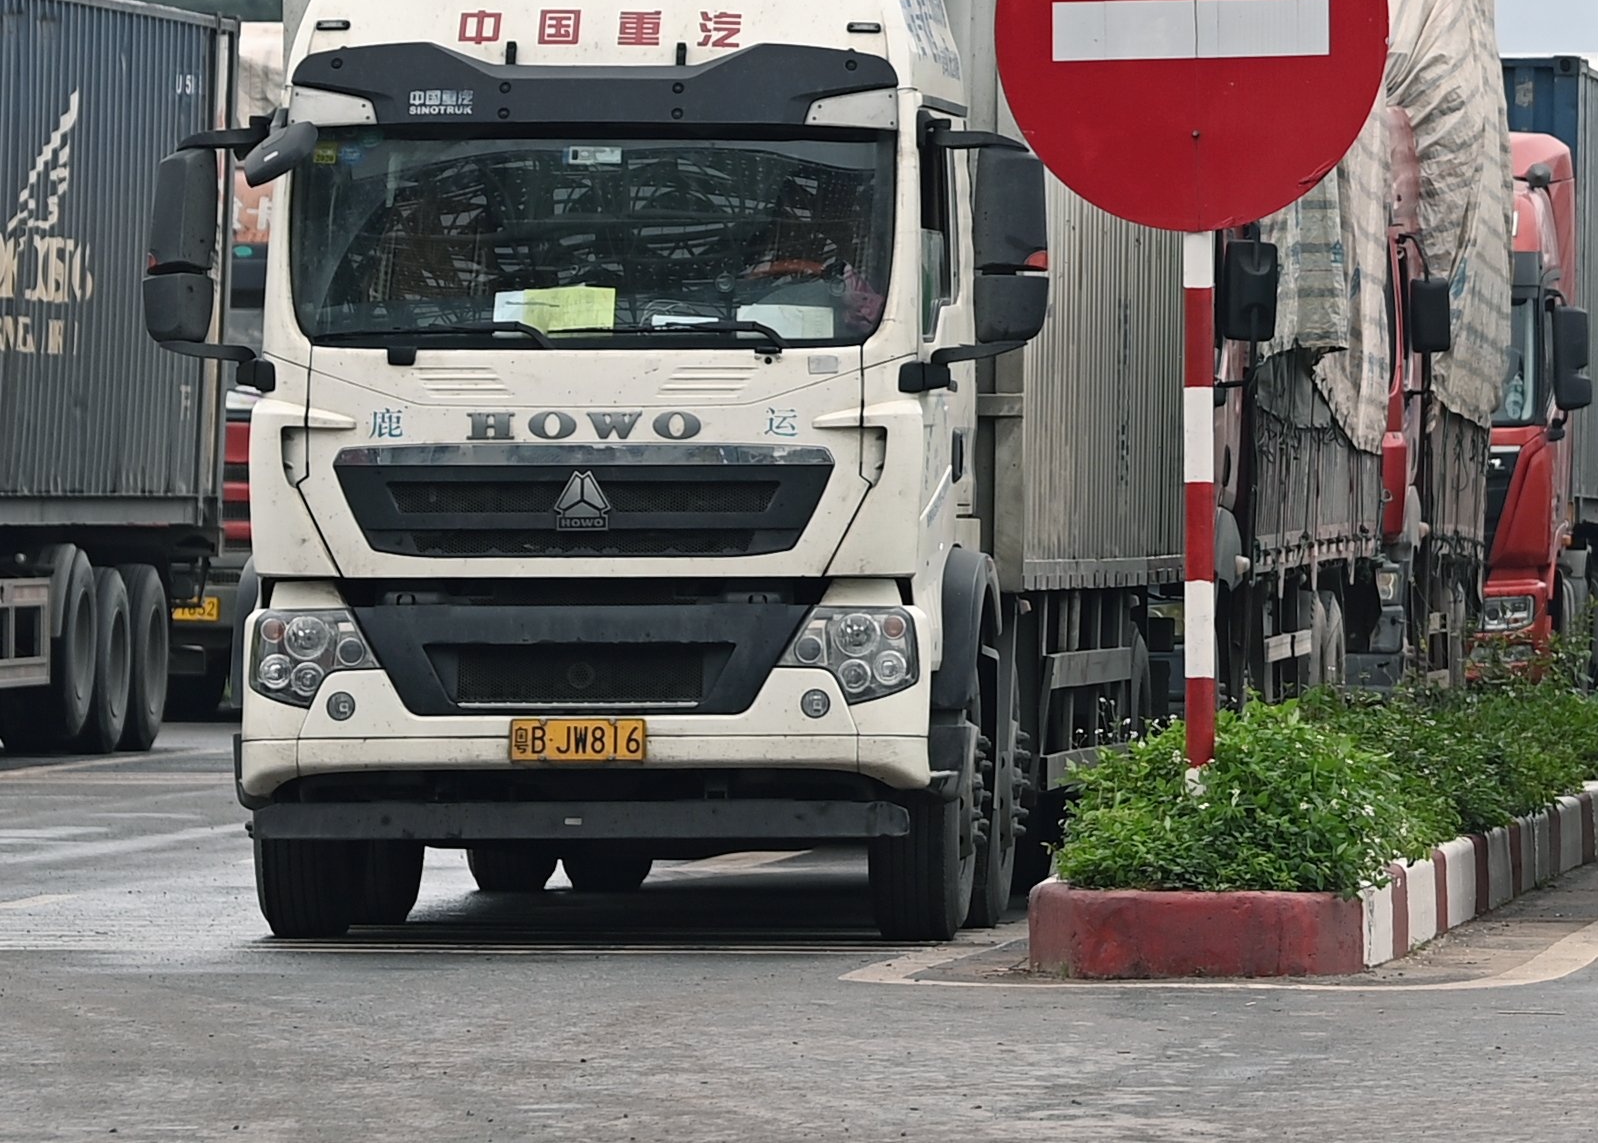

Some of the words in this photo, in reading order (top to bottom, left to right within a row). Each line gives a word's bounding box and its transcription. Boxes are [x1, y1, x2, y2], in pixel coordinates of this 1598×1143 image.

[457, 9, 743, 48] 中国重汽
[409, 89, 474, 105] 中国重汽
[409, 105, 473, 115] SINOTRUK
[369, 407, 404, 439] 鹿
[466, 410, 702, 441] HOWO
[763, 406, 799, 438] 运
[561, 518, 604, 527] HOWO
